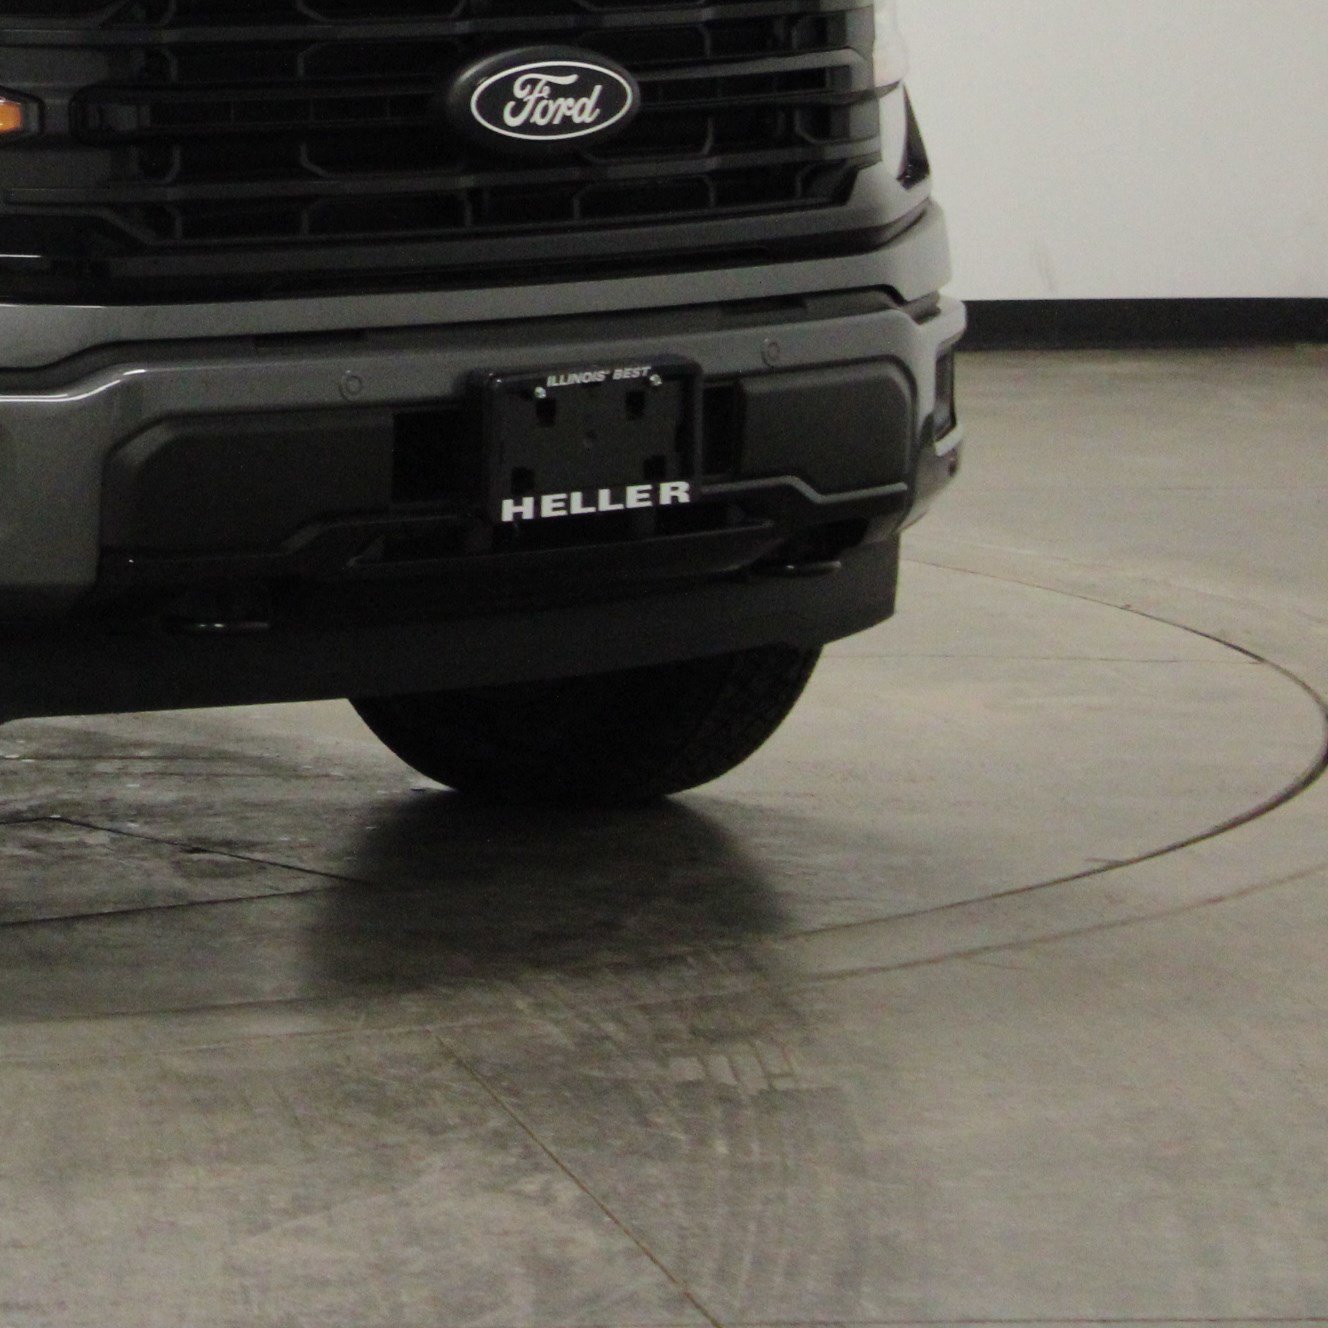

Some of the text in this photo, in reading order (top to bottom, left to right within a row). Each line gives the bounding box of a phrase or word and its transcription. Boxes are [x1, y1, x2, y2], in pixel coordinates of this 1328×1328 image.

[503, 73, 603, 128] Ford
[613, 366, 652, 381] BEST
[501, 481, 691, 522] HELLER
